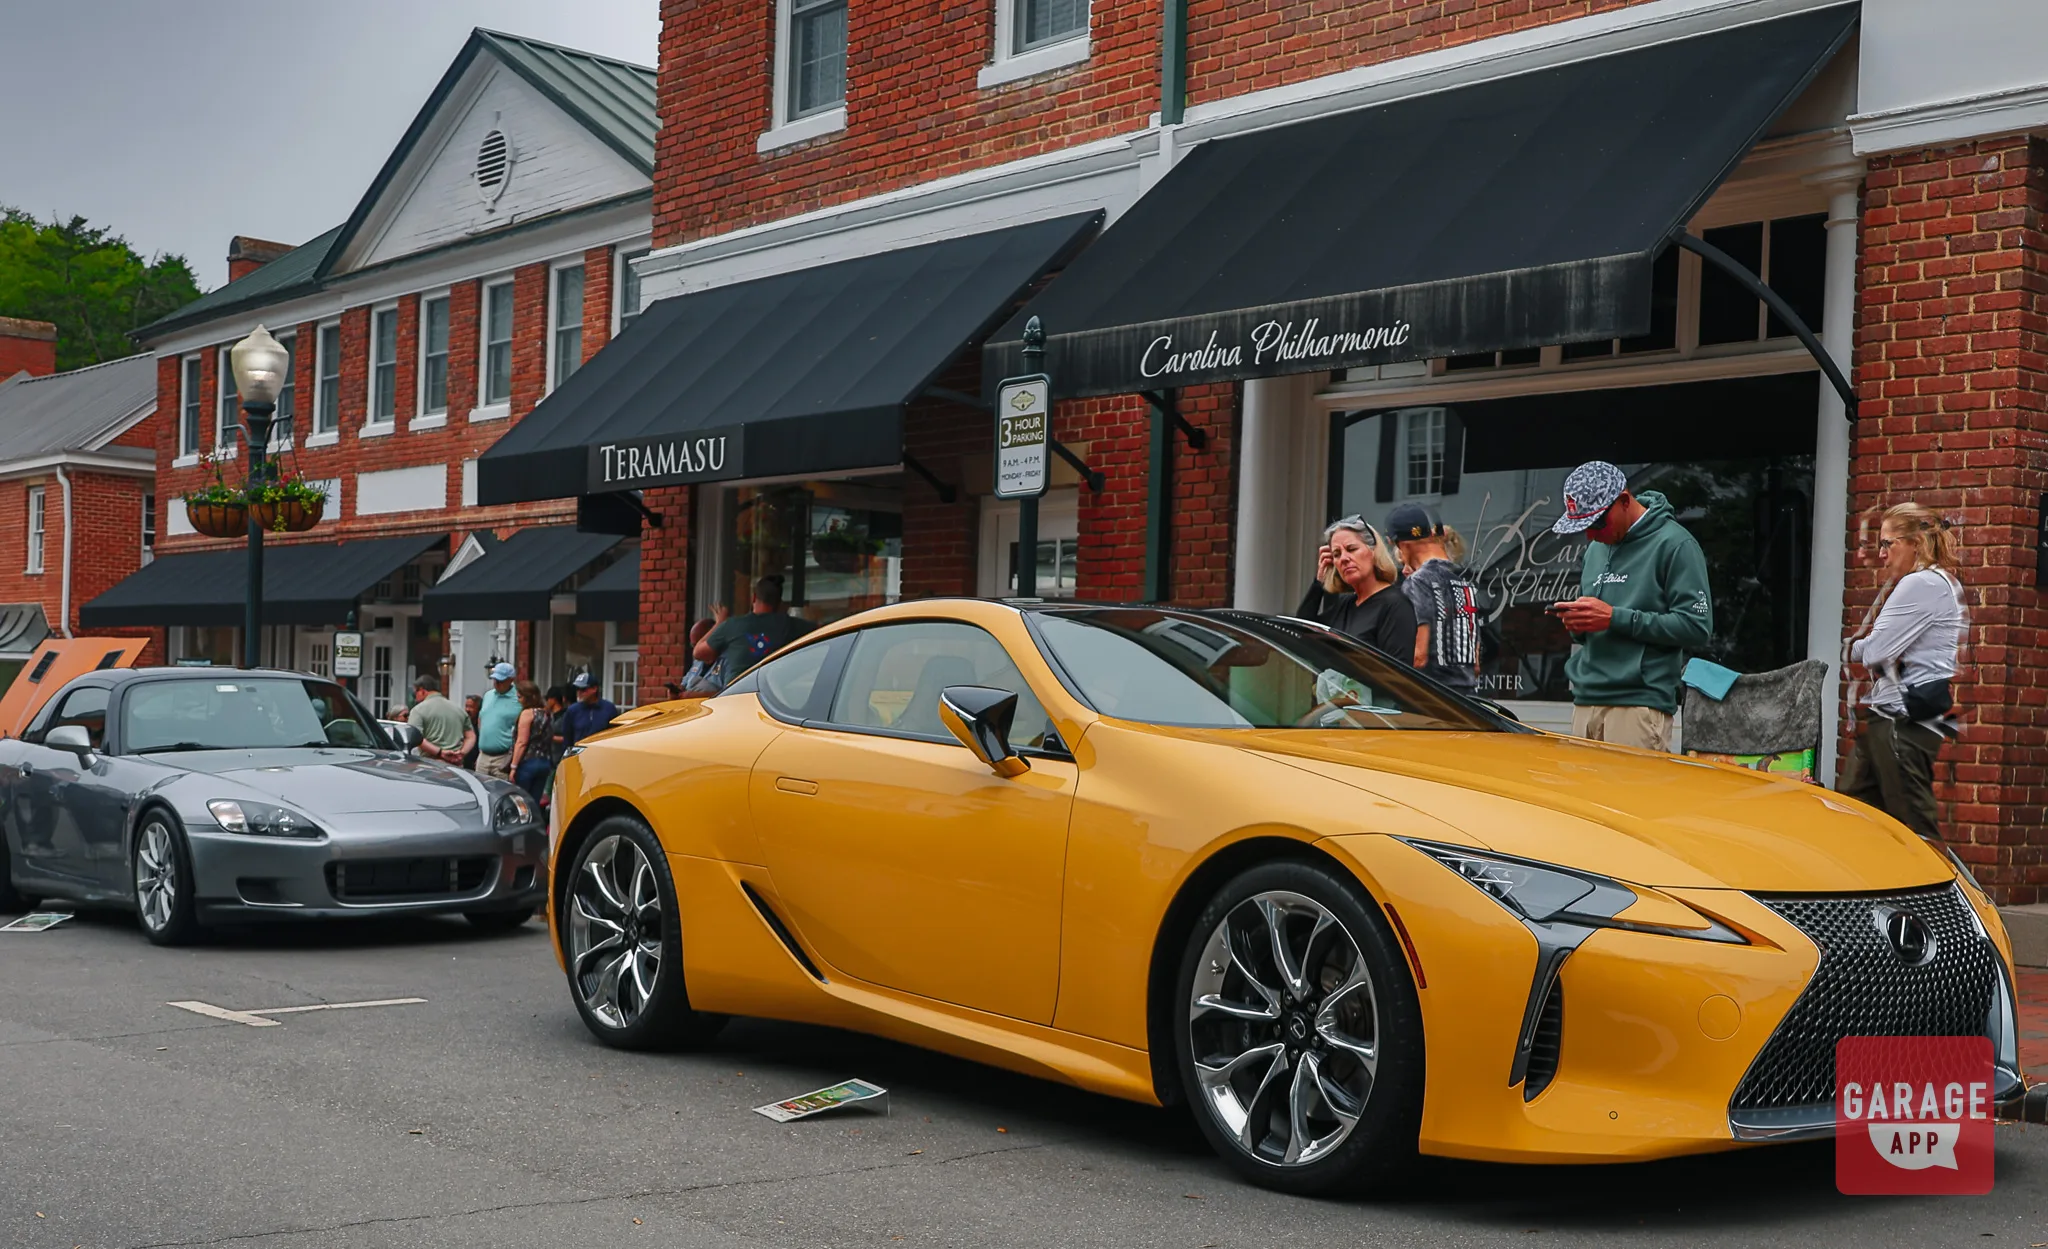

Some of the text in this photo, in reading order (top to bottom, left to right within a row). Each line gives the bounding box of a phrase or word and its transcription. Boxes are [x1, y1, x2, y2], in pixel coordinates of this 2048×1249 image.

[1140, 317, 1410, 378] Carolina Philharmonic
[1002, 417, 1041, 447] 3 HOUR
[1012, 430, 1043, 443] PARKING
[600, 436, 727, 482] TERAMASU
[1001, 471, 1022, 481] MONDAY
[1025, 469, 1041, 478] FRIDAY
[337, 645, 343, 657] 3
[1477, 674, 1524, 690] ENTER
